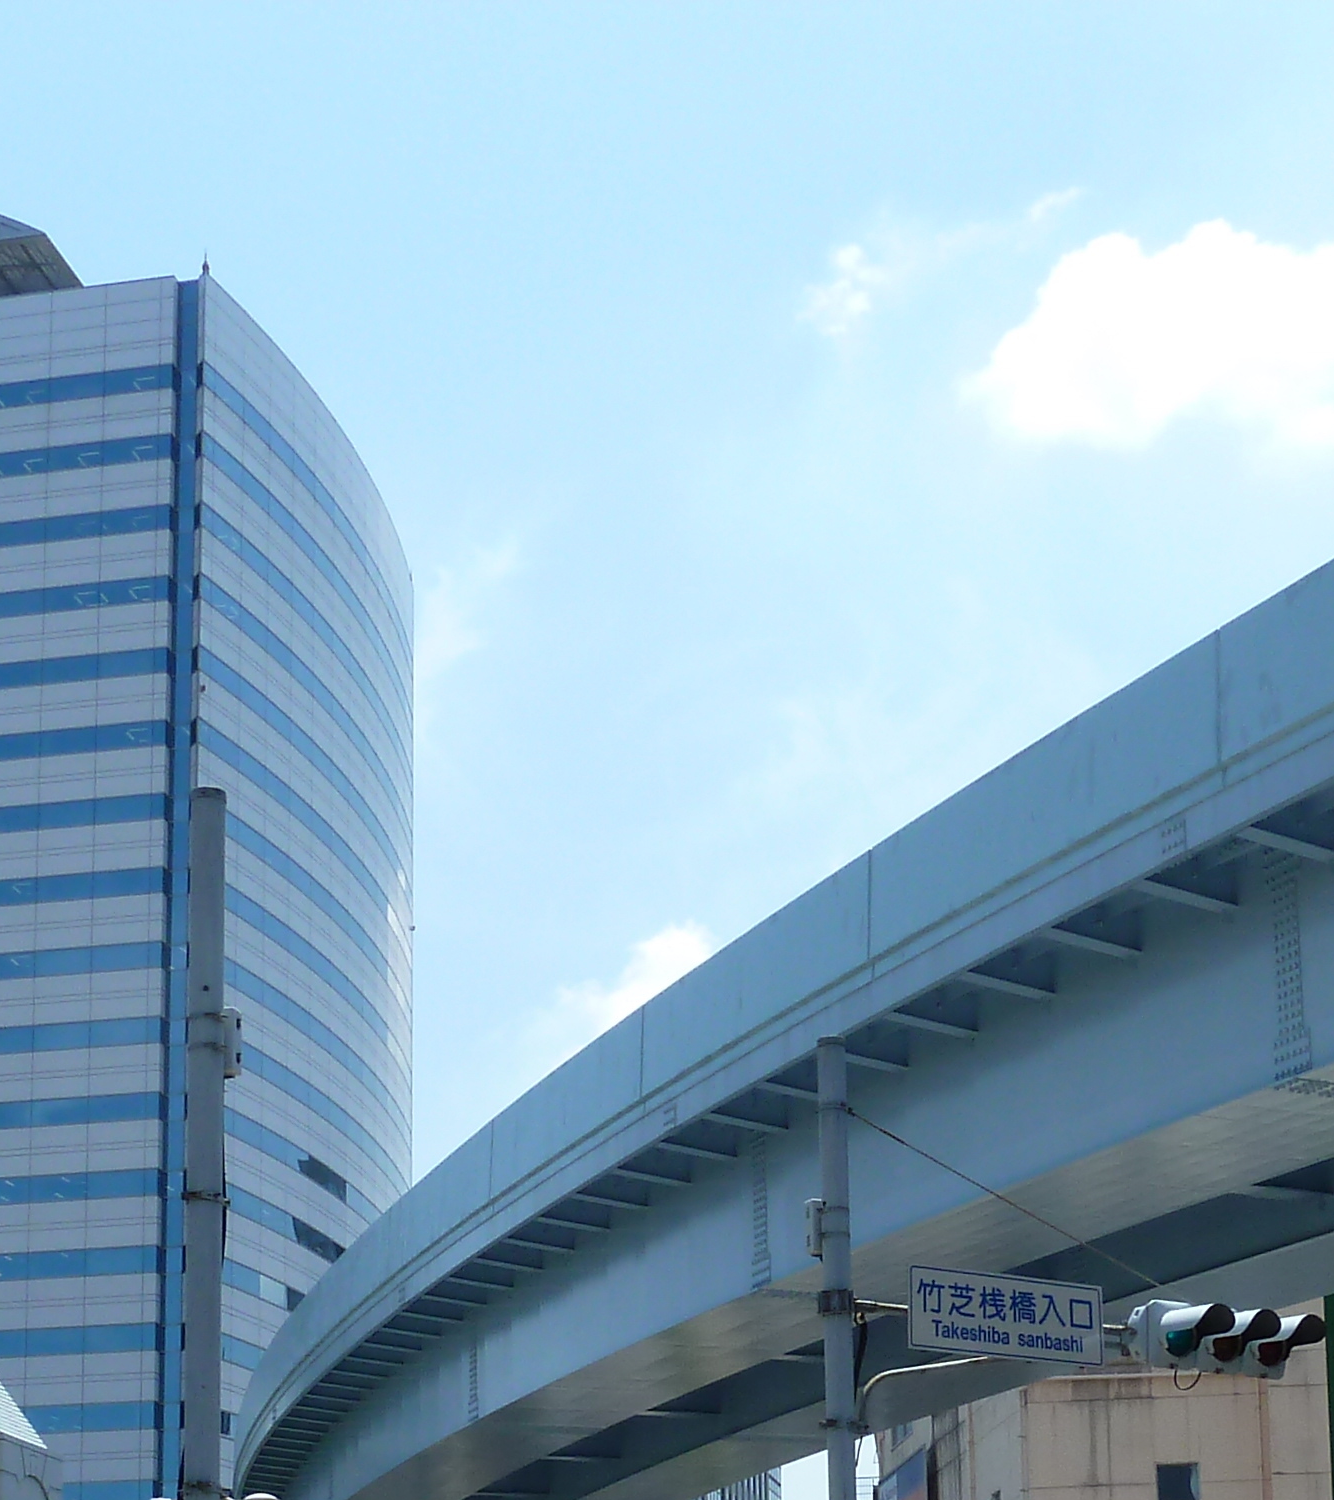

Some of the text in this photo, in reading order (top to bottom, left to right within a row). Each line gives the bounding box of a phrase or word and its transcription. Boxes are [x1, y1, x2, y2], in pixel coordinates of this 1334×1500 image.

[916, 1278, 1094, 1330] 竹芝桟橋入口
[931, 1318, 1084, 1354] Takeshiba sanbashi
